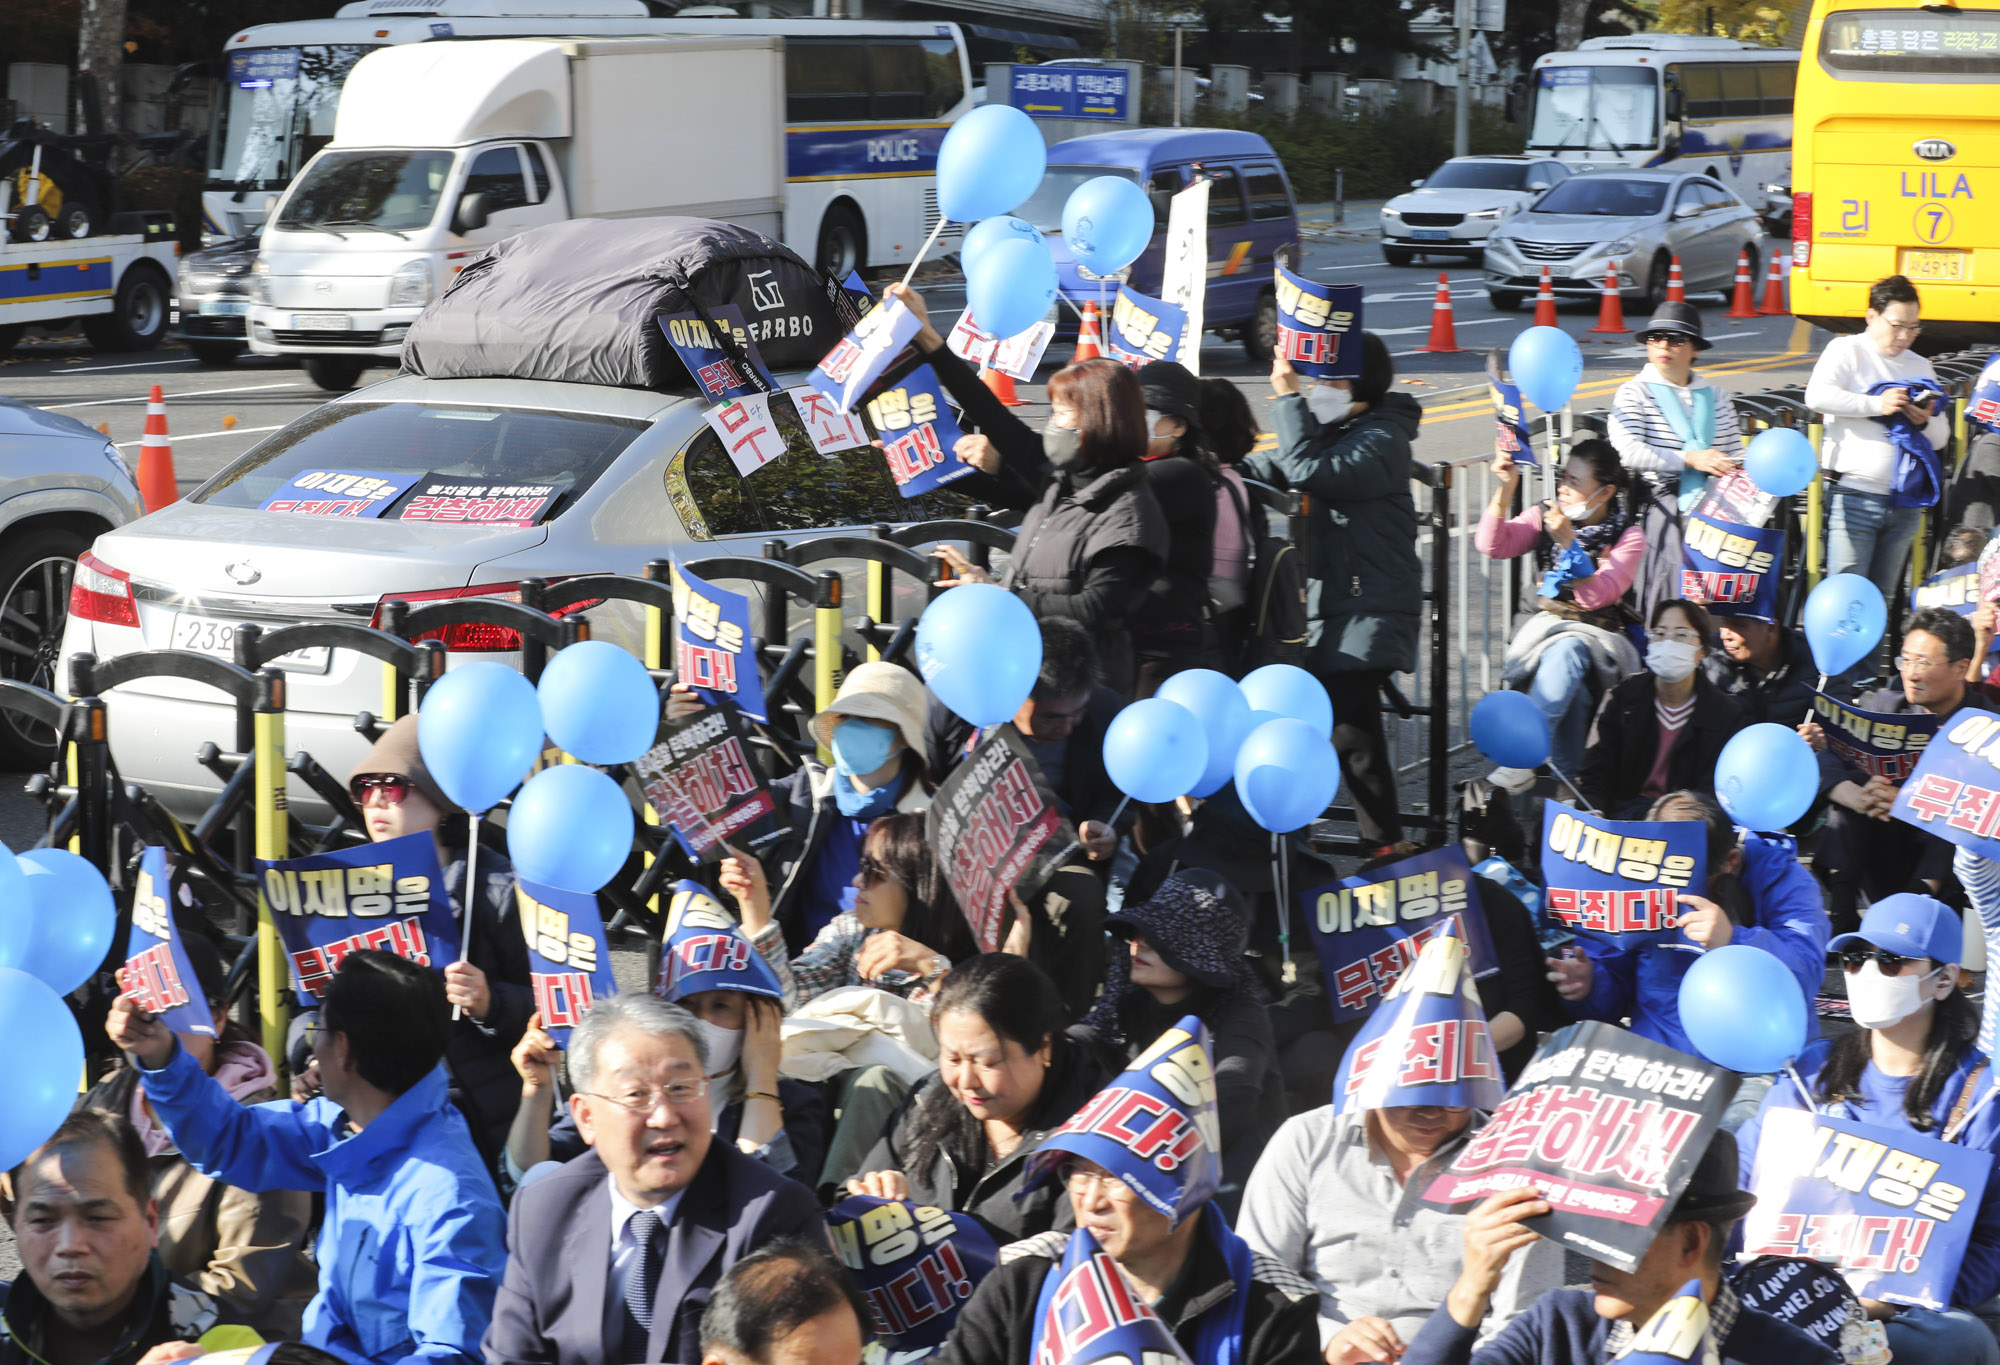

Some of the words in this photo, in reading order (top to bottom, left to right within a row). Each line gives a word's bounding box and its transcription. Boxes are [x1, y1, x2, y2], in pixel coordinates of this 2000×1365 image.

[867, 139, 919, 162] POLICE
[1918, 143, 1951, 158] KIA
[1901, 171, 1974, 199] LILA
[747, 315, 813, 342] ERRBO
[1277, 323, 1341, 364] 다!
[718, 402, 767, 463] 무
[866, 387, 938, 432] 명은
[884, 422, 945, 486] 다!
[293, 471, 398, 500] 이재명은
[400, 496, 548, 520] 검찰해체
[673, 569, 744, 654] 명은
[676, 639, 738, 694] 다!
[1814, 696, 1931, 751] 이재명은
[1549, 812, 1696, 888] 이재명은
[264, 863, 430, 918] 이재명은
[1316, 870, 1469, 934] 이재명은
[1546, 887, 1679, 934] 무죄다!
[515, 884, 598, 973] 명은
[529, 972, 596, 1031] 다!
[1580, 1049, 1715, 1102] 탄핵하라!
[1050, 1086, 1205, 1172] 죄다!
[1450, 1083, 1703, 1196] 검찰해체
[830, 1201, 958, 1270] 명은
[1758, 1261, 1808, 1301] PANY
[1772, 1288, 1815, 1323] CHEL
